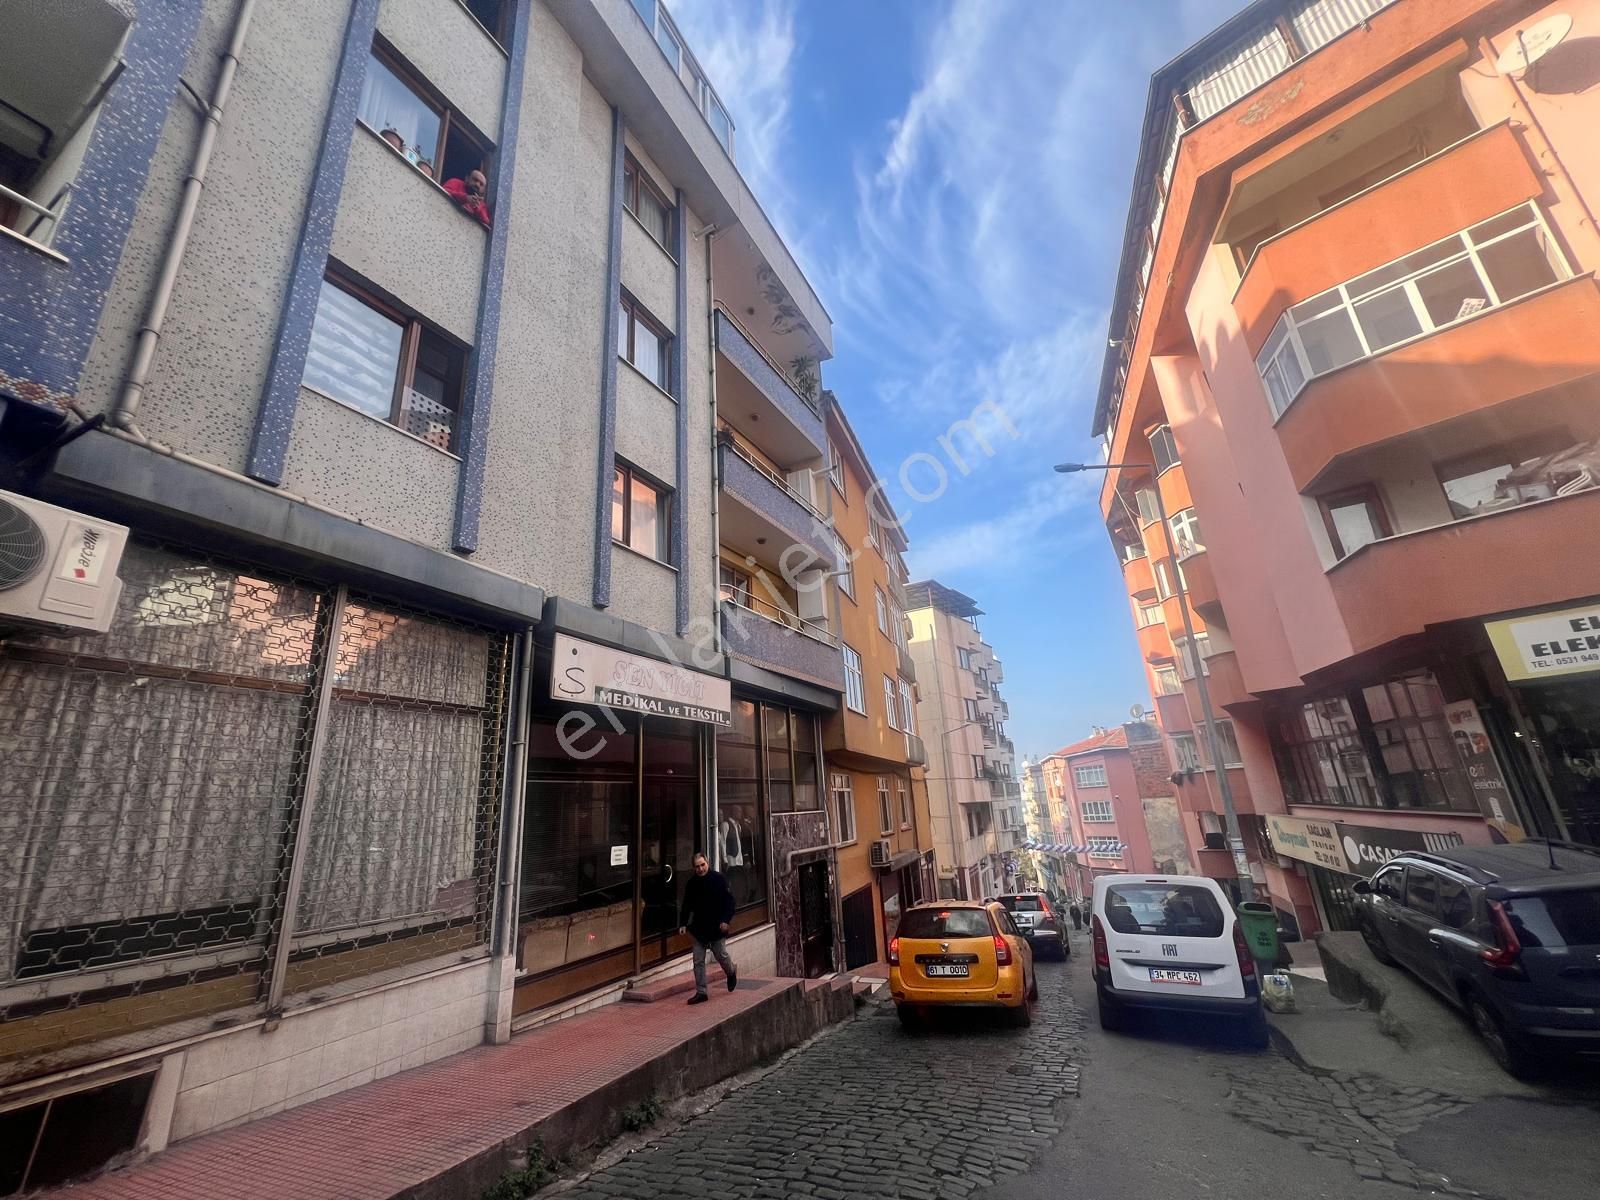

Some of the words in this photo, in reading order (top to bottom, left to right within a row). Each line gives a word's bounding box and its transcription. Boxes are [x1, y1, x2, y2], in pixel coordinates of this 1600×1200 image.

[78, 528, 101, 568] arçelik
[1531, 660, 1554, 669] TEL:
[1556, 656, 1579, 666] 0531
[1581, 653, 1600, 663] 949
[599, 690, 665, 713] MEDİKAL
[1162, 944, 1178, 957] FIAT
[1154, 970, 1164, 979] 34
[1167, 971, 1181, 981] MPC
[1183, 972, 1199, 982] 462
